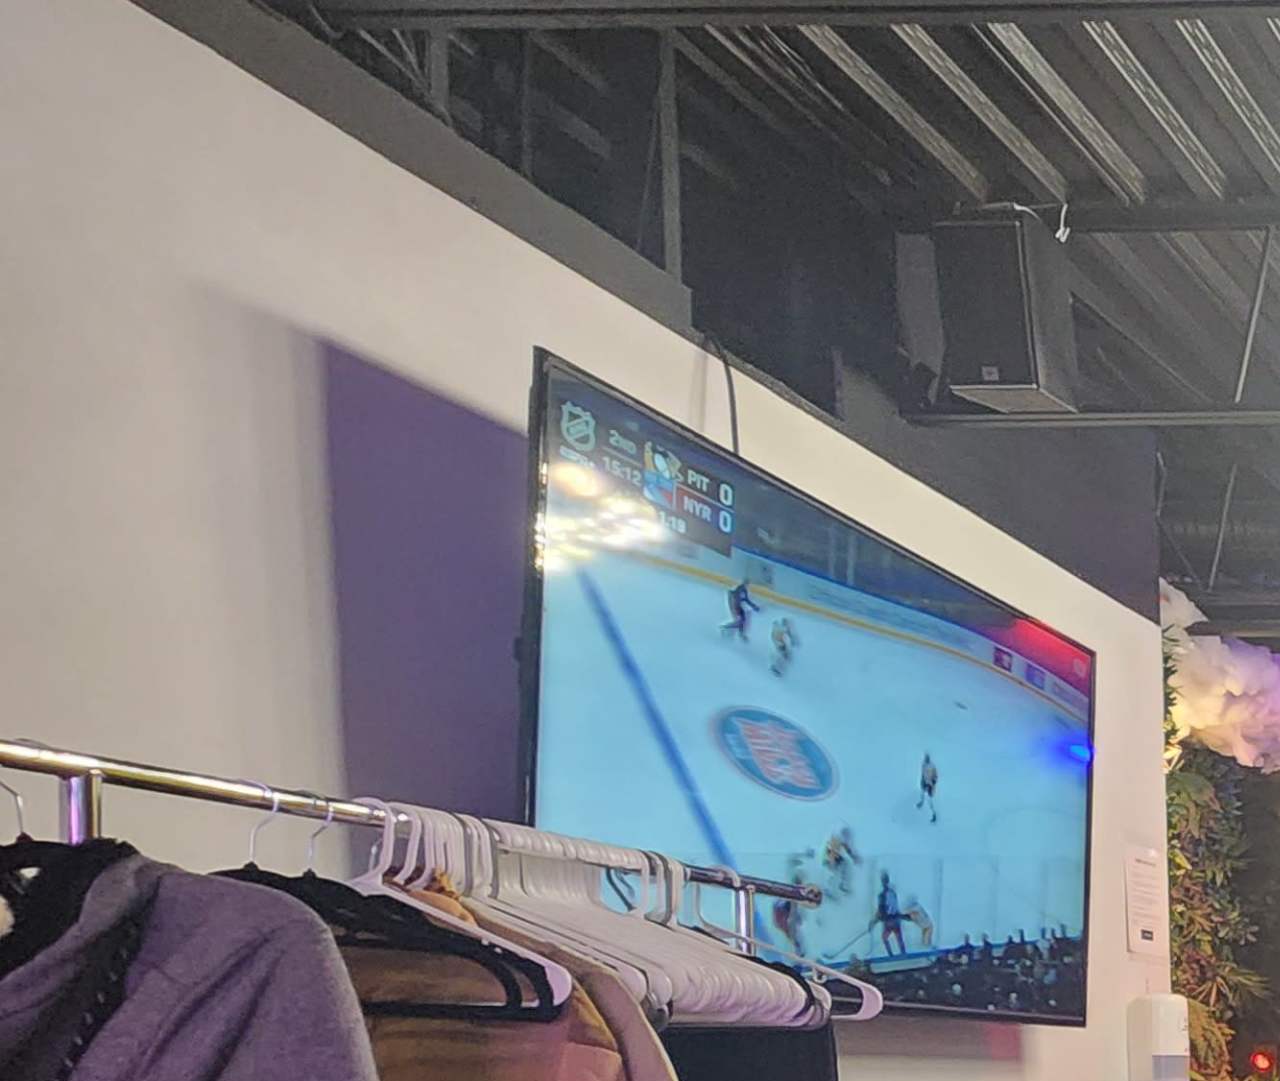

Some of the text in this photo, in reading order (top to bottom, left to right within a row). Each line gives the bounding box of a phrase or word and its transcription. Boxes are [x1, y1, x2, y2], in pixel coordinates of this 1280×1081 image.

[687, 468, 733, 506] PIT 0
[683, 495, 732, 534] NYR 0
